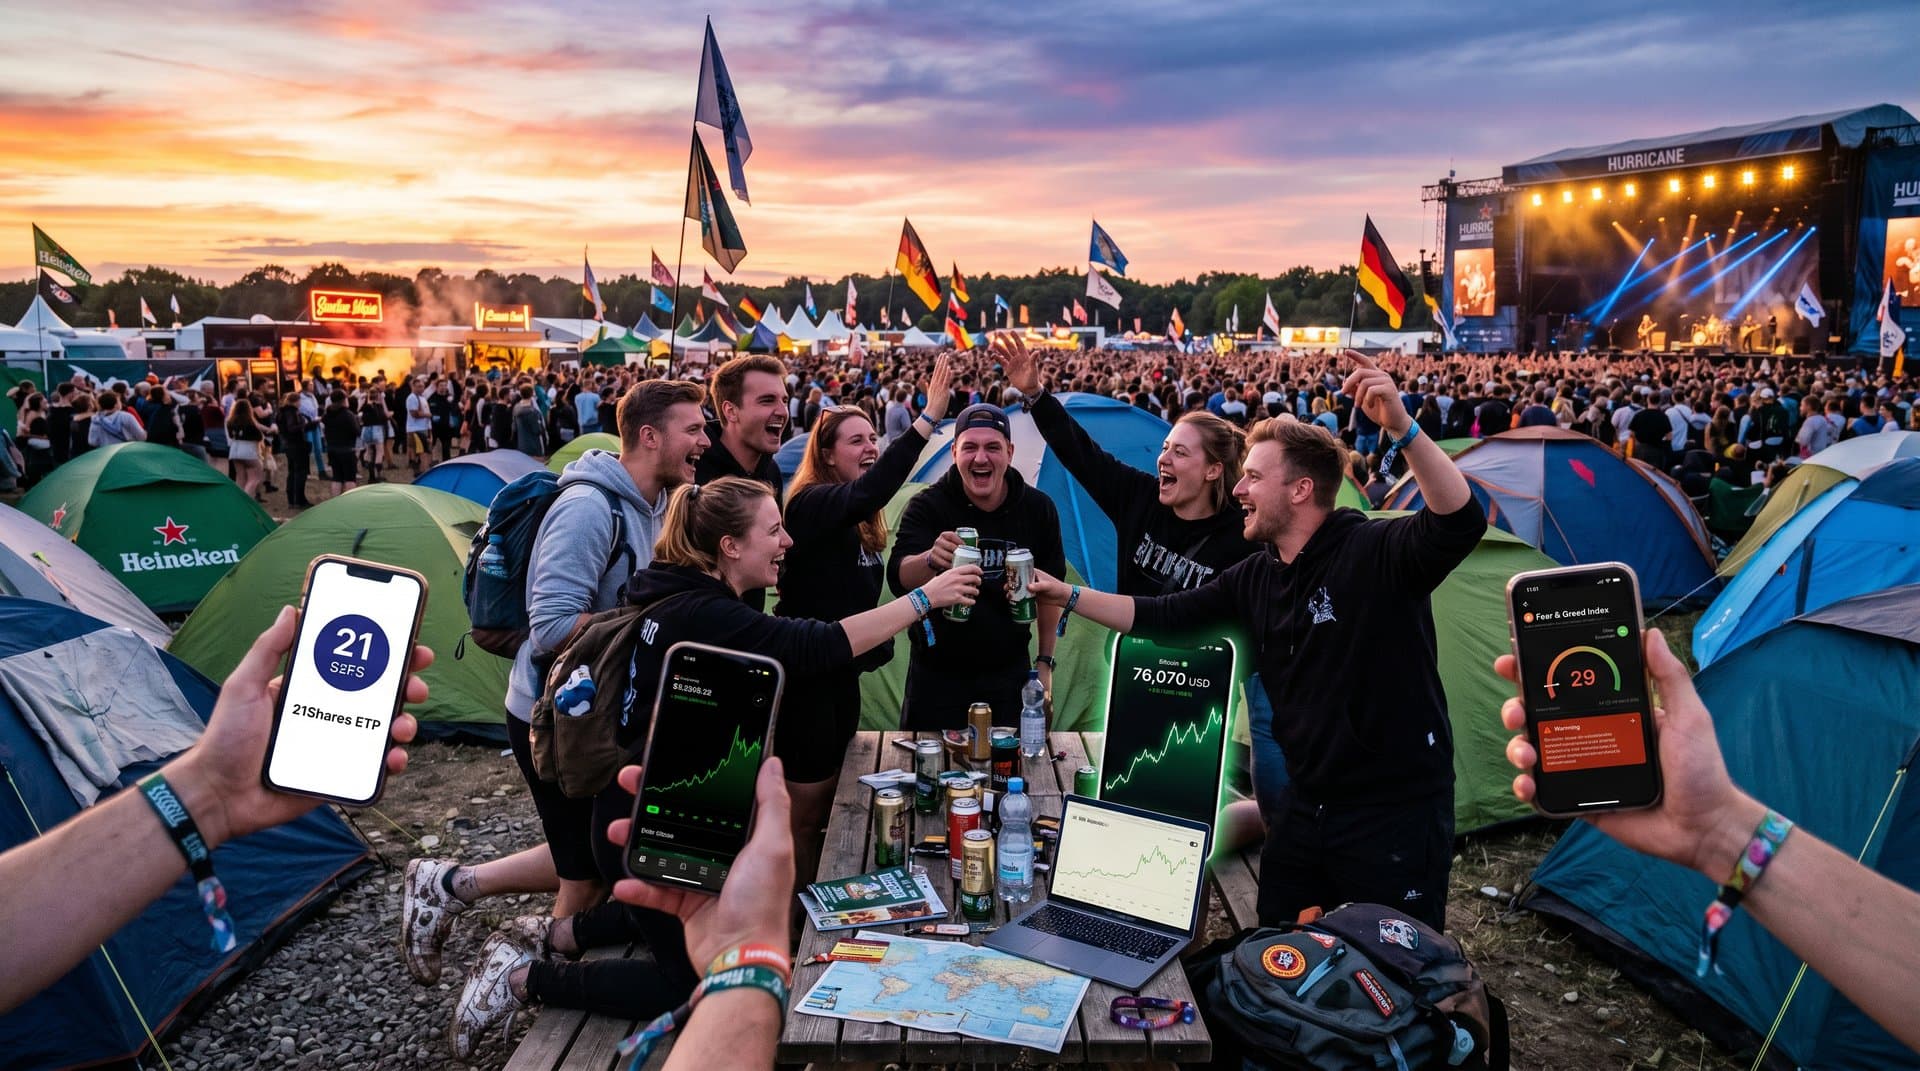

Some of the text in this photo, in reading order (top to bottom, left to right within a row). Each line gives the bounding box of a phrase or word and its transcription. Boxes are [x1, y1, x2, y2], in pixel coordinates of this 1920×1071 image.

[1607, 147, 1685, 172] HURRICANE
[120, 548, 240, 572] Heineken
[1535, 606, 1609, 621] Fear & Greed Index
[332, 627, 373, 661] 21
[1132, 666, 1211, 688] 76,070 USD
[1570, 669, 1596, 688] 29
[292, 703, 381, 731] 21Shares ETP
